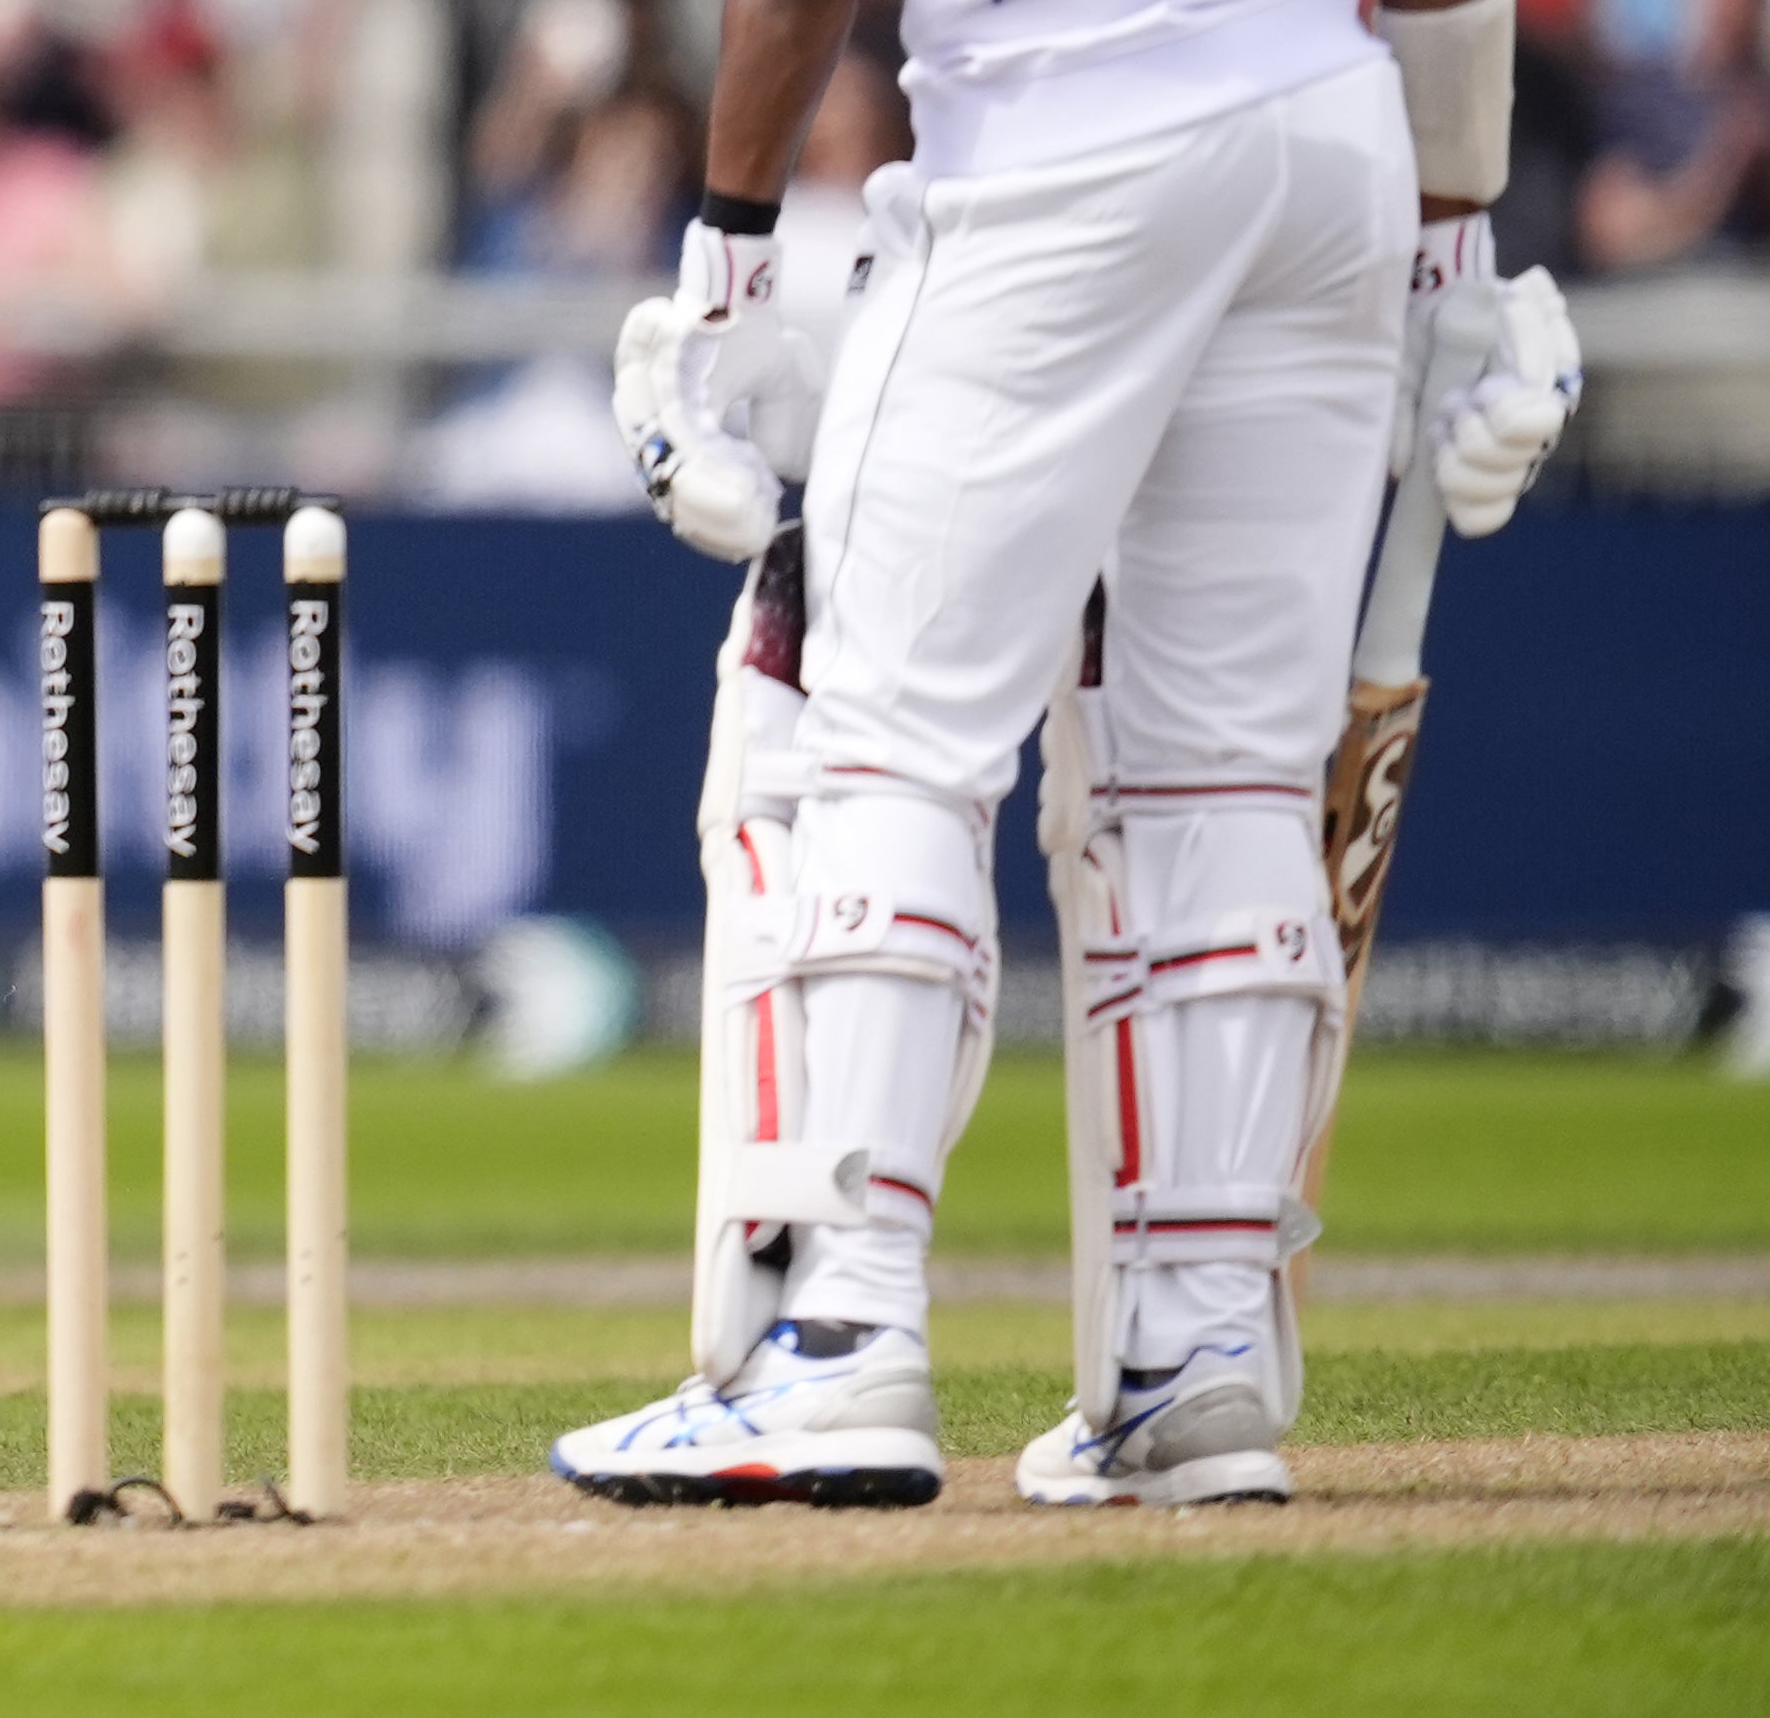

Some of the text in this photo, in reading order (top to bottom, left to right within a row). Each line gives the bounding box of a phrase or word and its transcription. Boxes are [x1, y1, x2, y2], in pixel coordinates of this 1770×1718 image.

[40, 600, 75, 855] Rothesay
[164, 603, 205, 859] Rothesay
[286, 599, 329, 856] Rothesay
